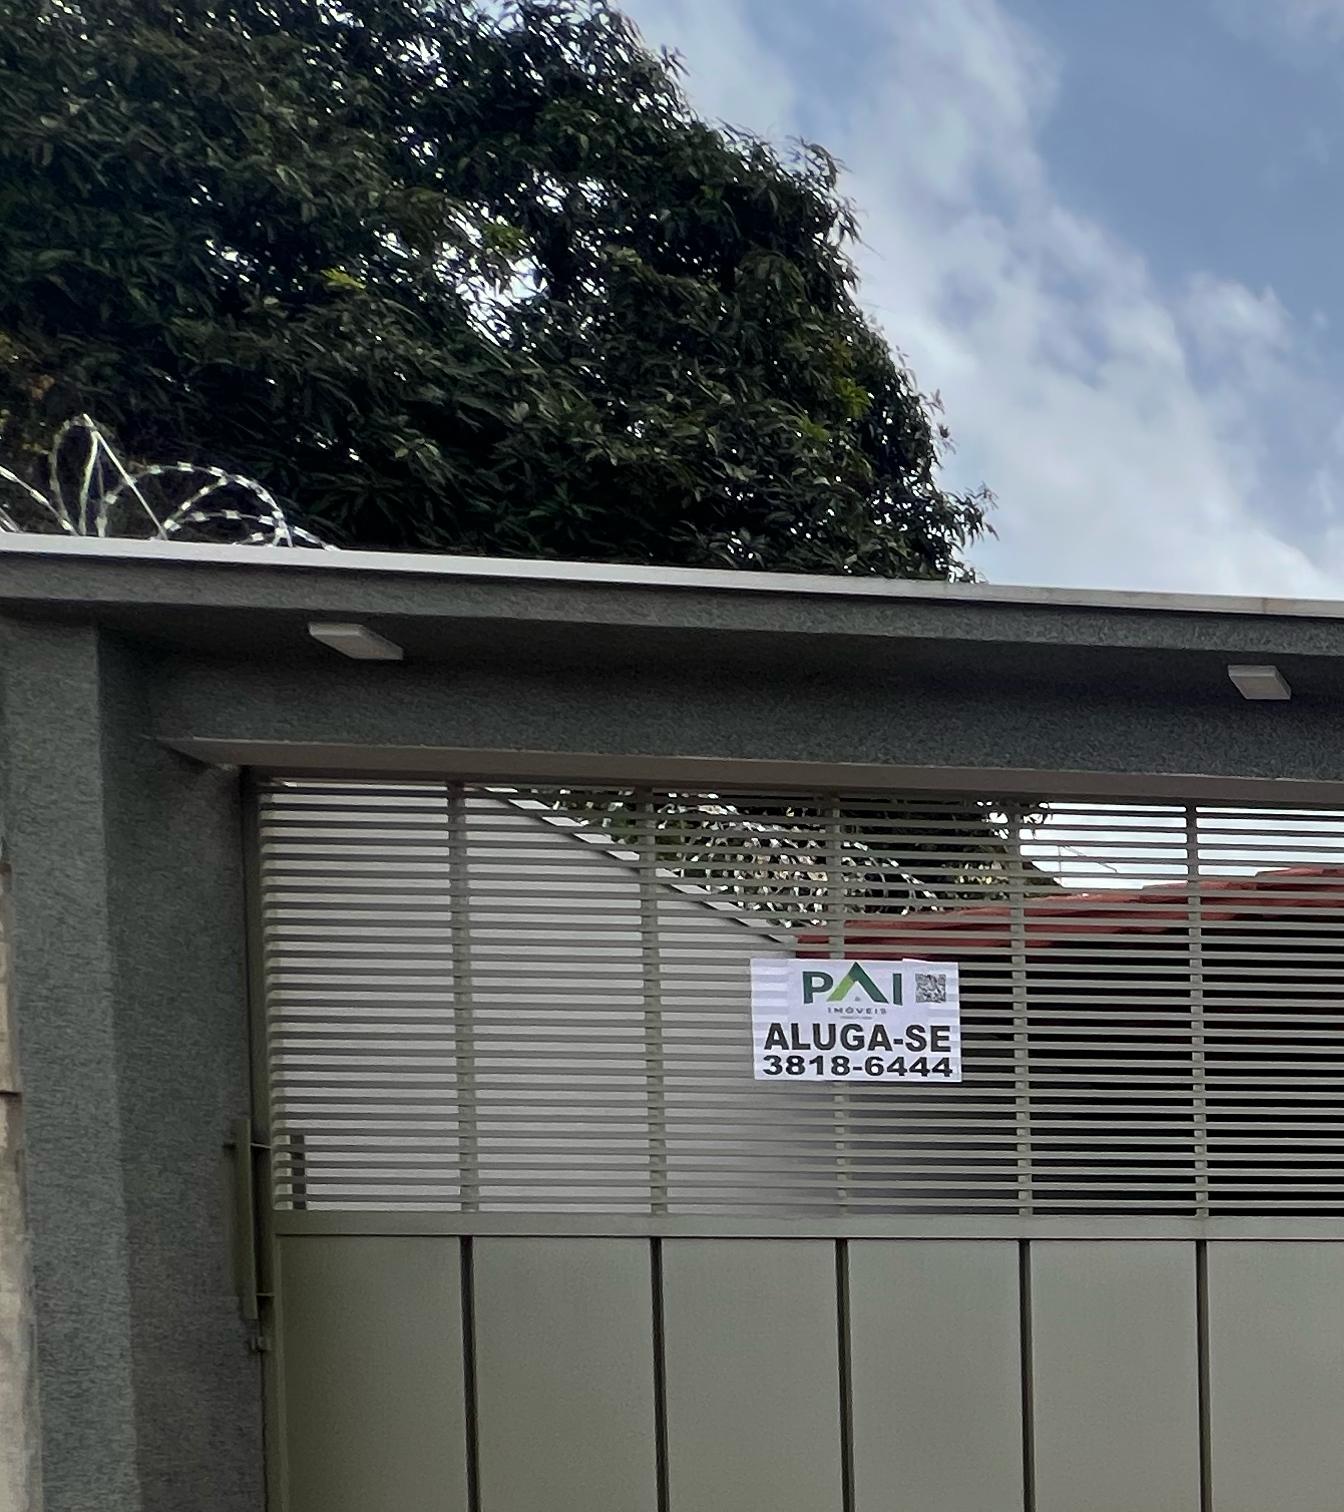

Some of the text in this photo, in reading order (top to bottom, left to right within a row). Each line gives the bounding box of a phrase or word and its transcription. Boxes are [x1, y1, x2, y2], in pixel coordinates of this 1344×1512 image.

[802, 961, 904, 1006] PAI
[764, 1022, 951, 1053] ALUGA-SE
[762, 1055, 953, 1078] 3818-6444
